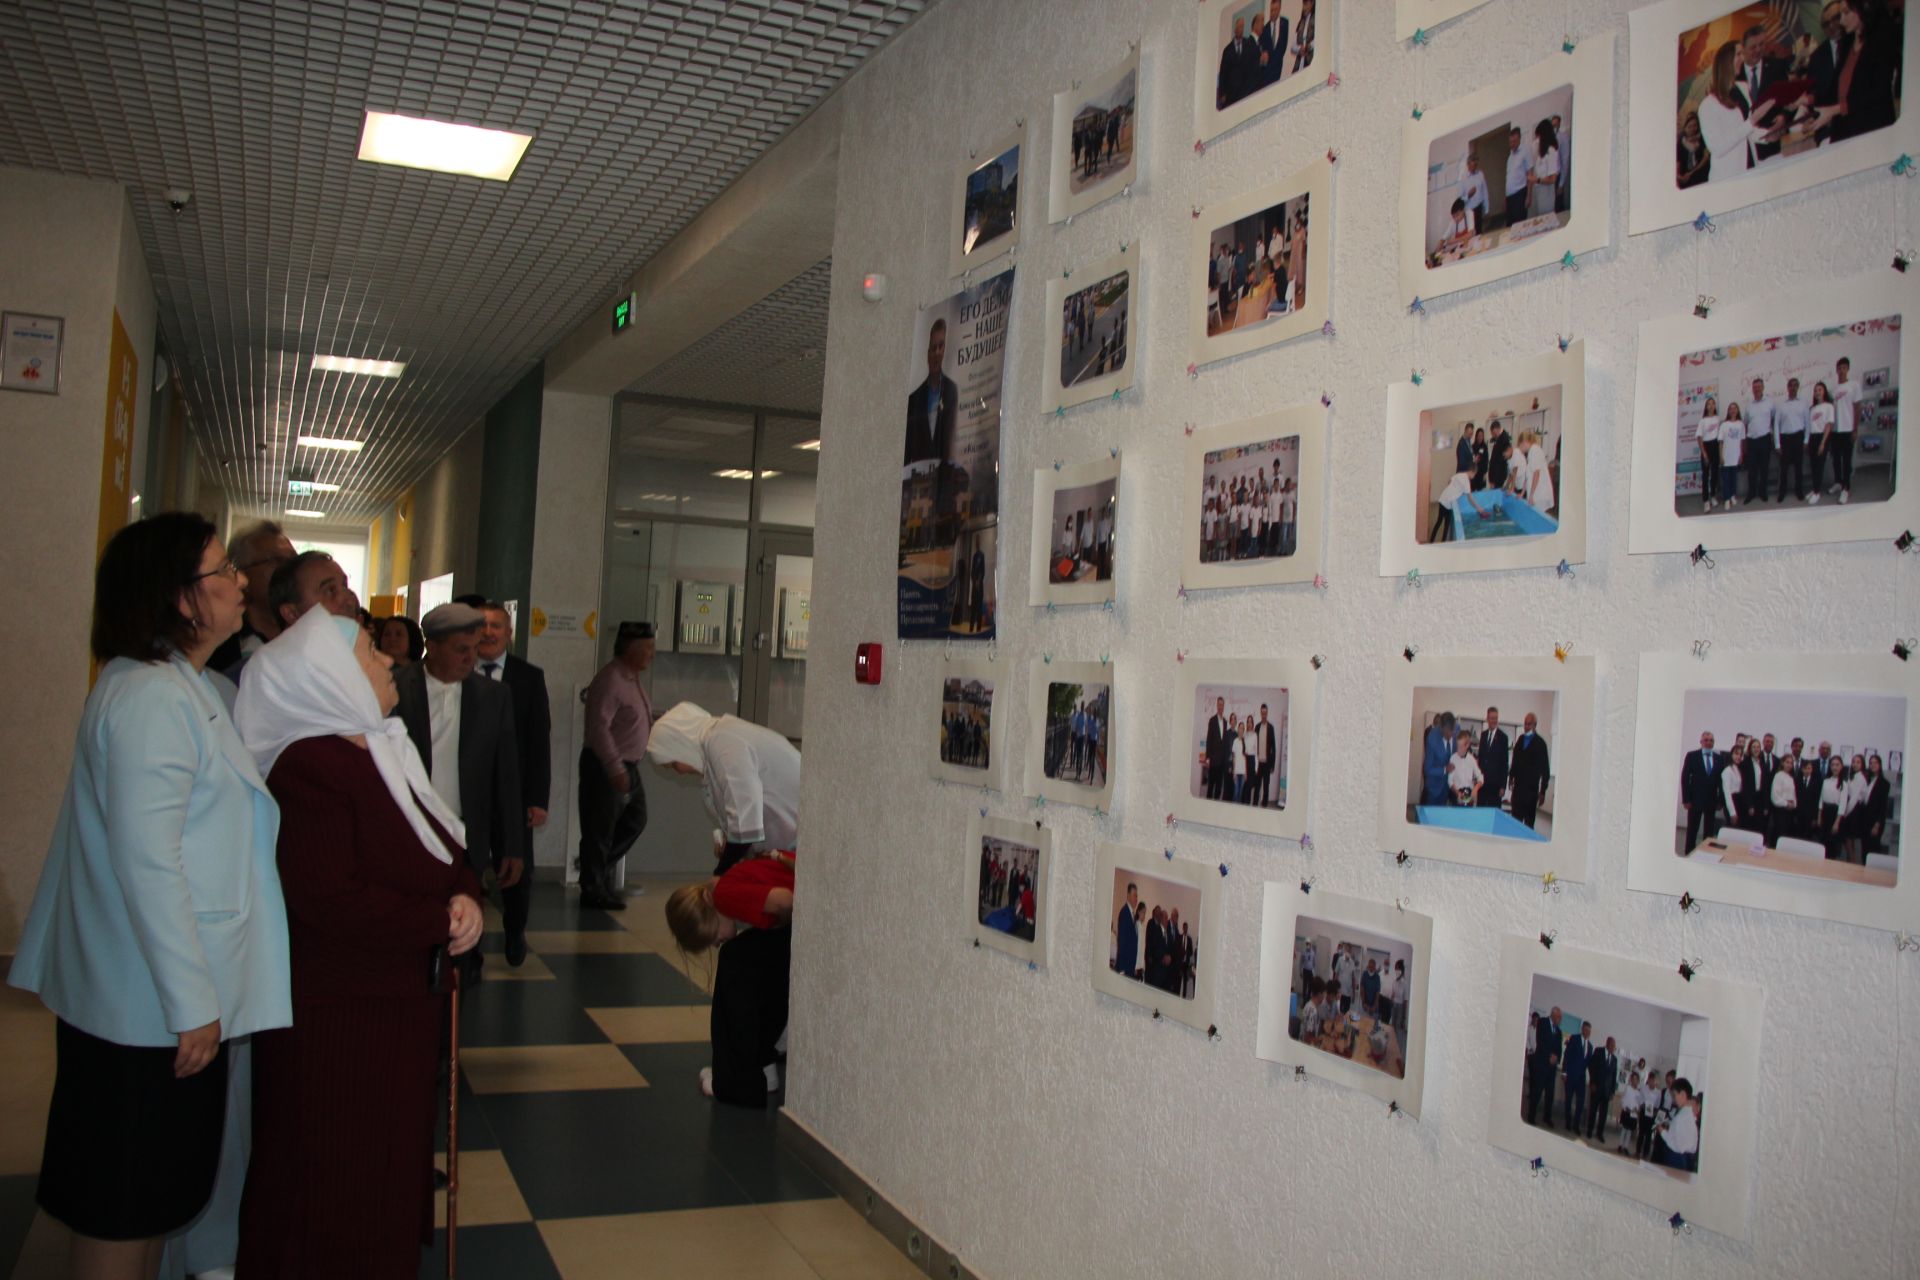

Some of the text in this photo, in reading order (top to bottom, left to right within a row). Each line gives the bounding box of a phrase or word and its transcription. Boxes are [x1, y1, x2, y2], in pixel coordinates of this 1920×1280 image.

[960, 303, 980, 324] ЕГО
[975, 311, 1004, 339] НАШЕ
[958, 333, 1004, 366] БУДУЩЕЕ
